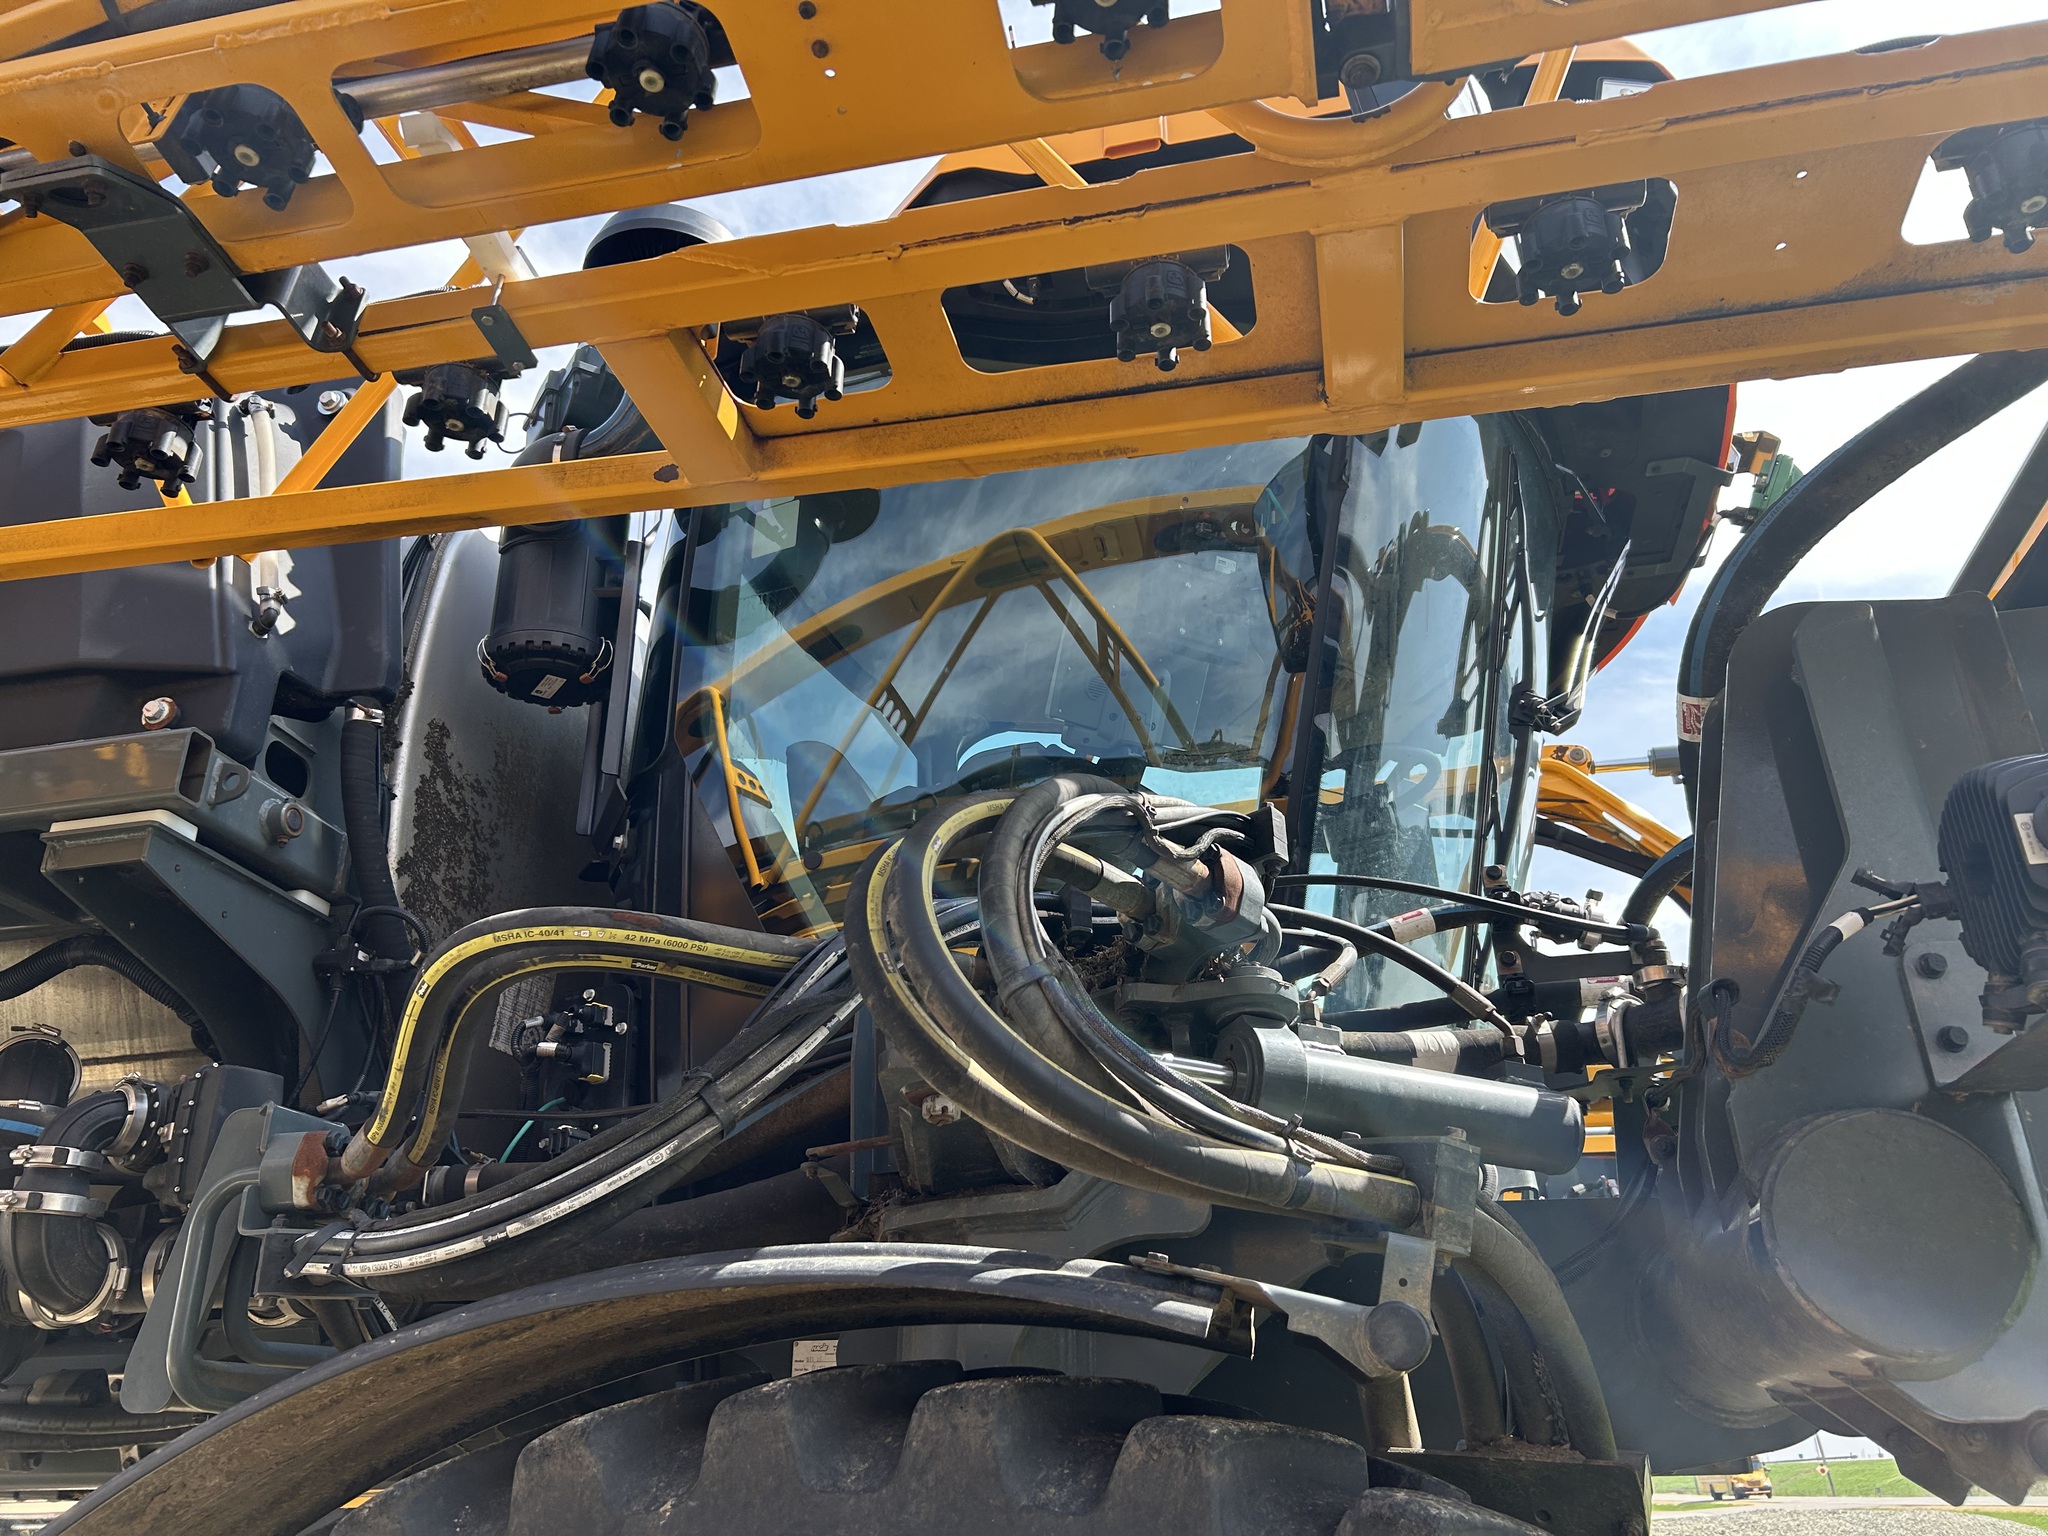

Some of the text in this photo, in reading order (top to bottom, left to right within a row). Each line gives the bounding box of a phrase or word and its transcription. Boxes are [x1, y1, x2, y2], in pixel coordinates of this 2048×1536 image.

[1760, 487, 1799, 527] VERSIFLO
[492, 931, 522, 944] MSHA
[524, 929, 565, 938] IC-40/41
[639, 935, 660, 945] MPa
[663, 938, 689, 950] (6000
[690, 943, 709, 952] PSI)
[632, 961, 657, 972] Parker
[485, 1231, 507, 1242] Parker
[360, 1265, 371, 1273] MPa
[371, 1263, 388, 1272] (3000
[389, 1260, 403, 1270] PSI)
